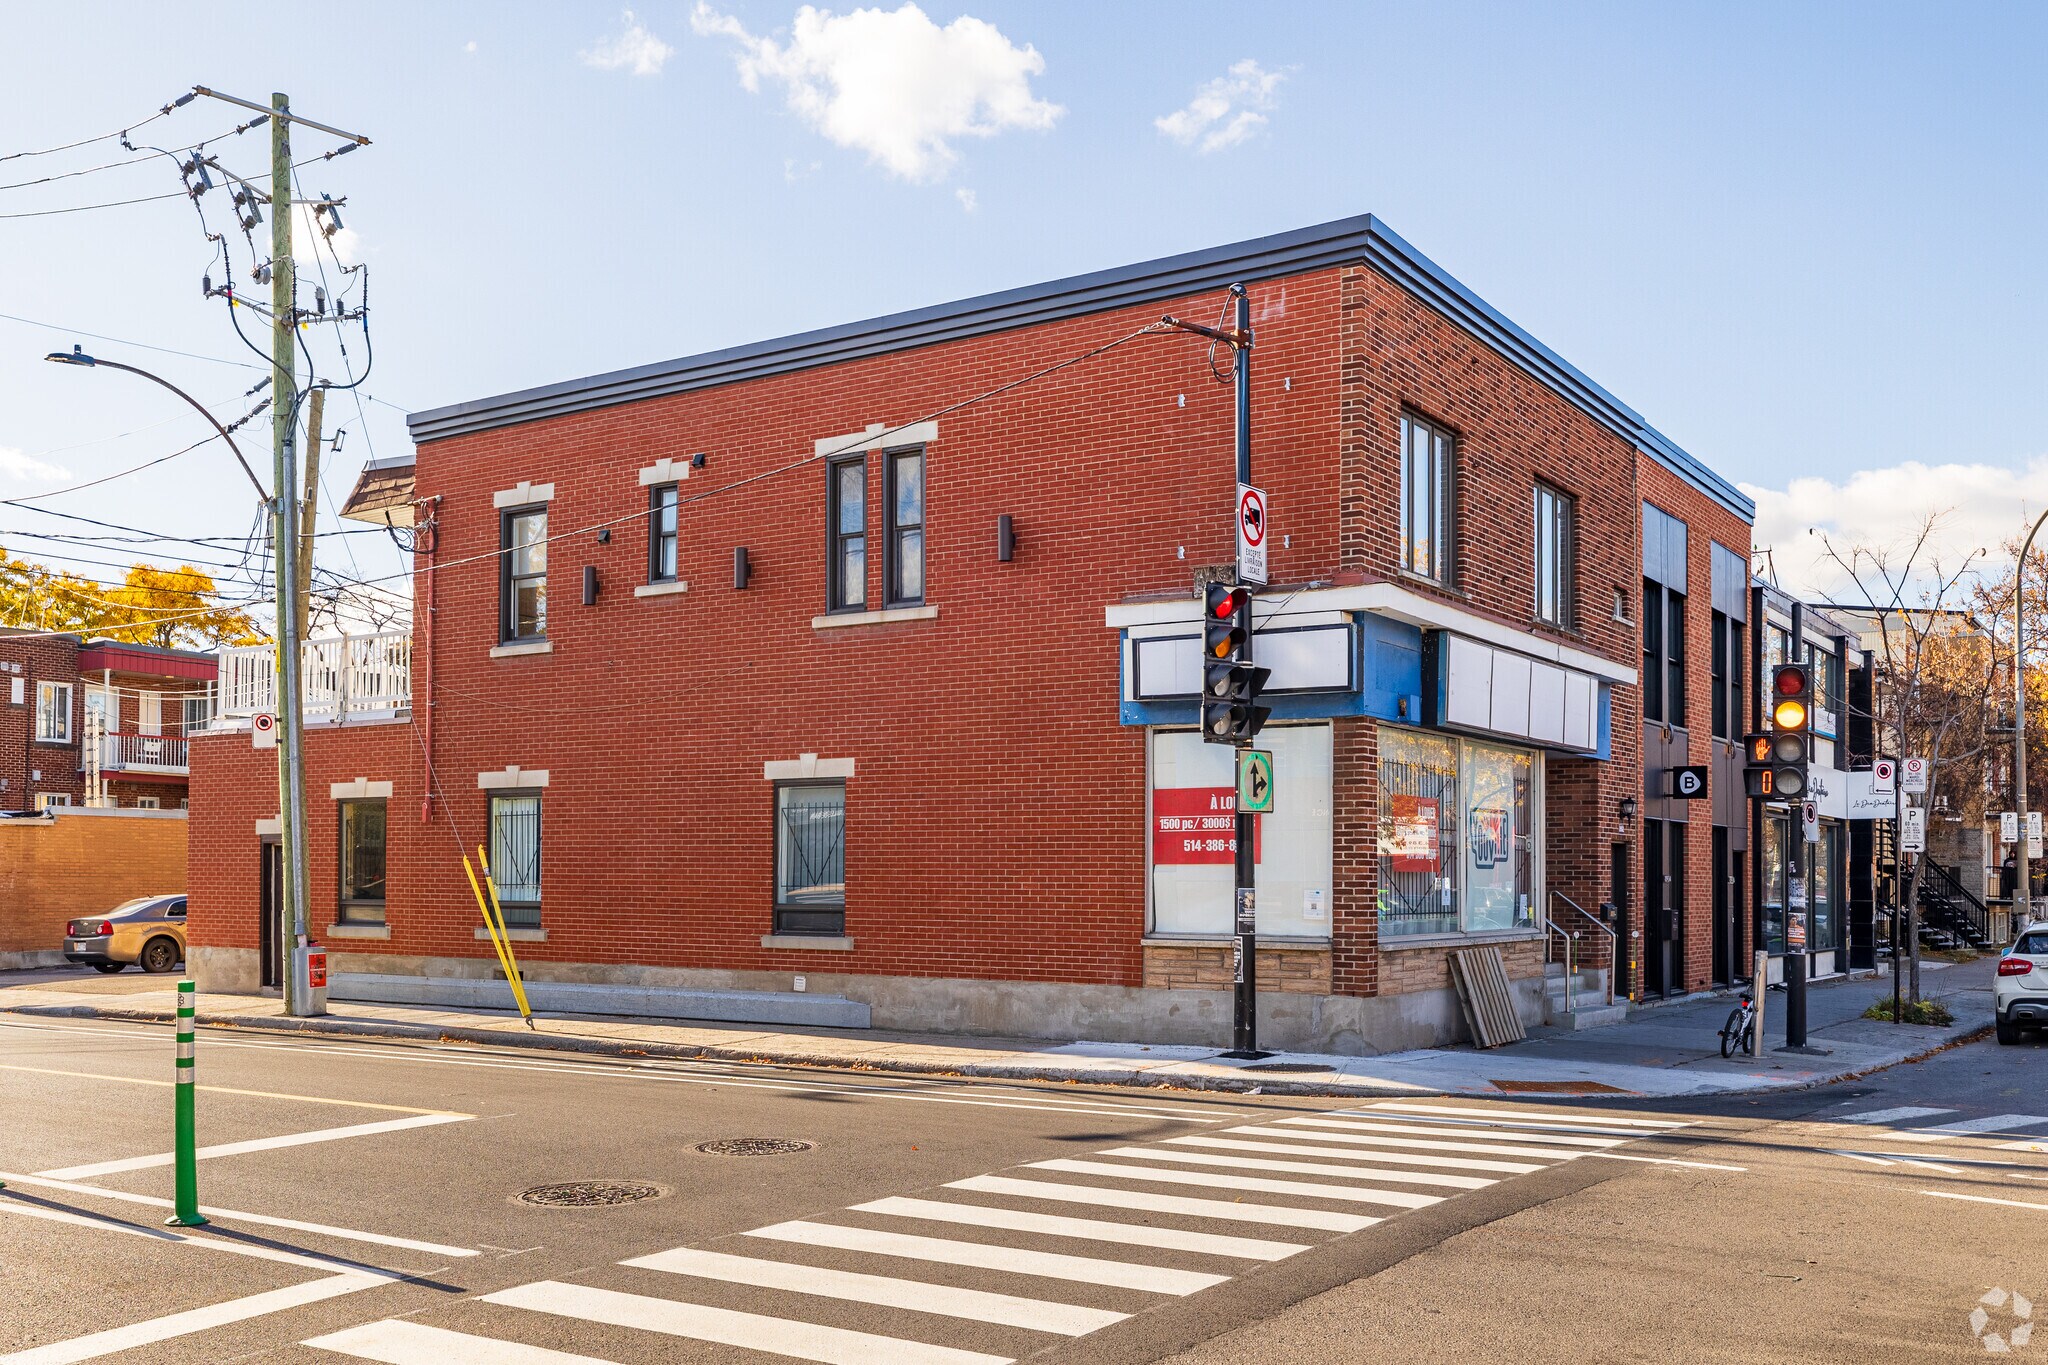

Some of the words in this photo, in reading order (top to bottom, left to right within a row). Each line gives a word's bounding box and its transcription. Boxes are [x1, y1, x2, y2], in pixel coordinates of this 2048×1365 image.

[1248, 566, 1260, 575] LOCALE
[1684, 776, 1695, 789] B
[1210, 794, 1218, 810] À
[1909, 811, 1916, 820] P
[1160, 818, 1180, 830] 1500
[1202, 816, 1231, 830] 3000$
